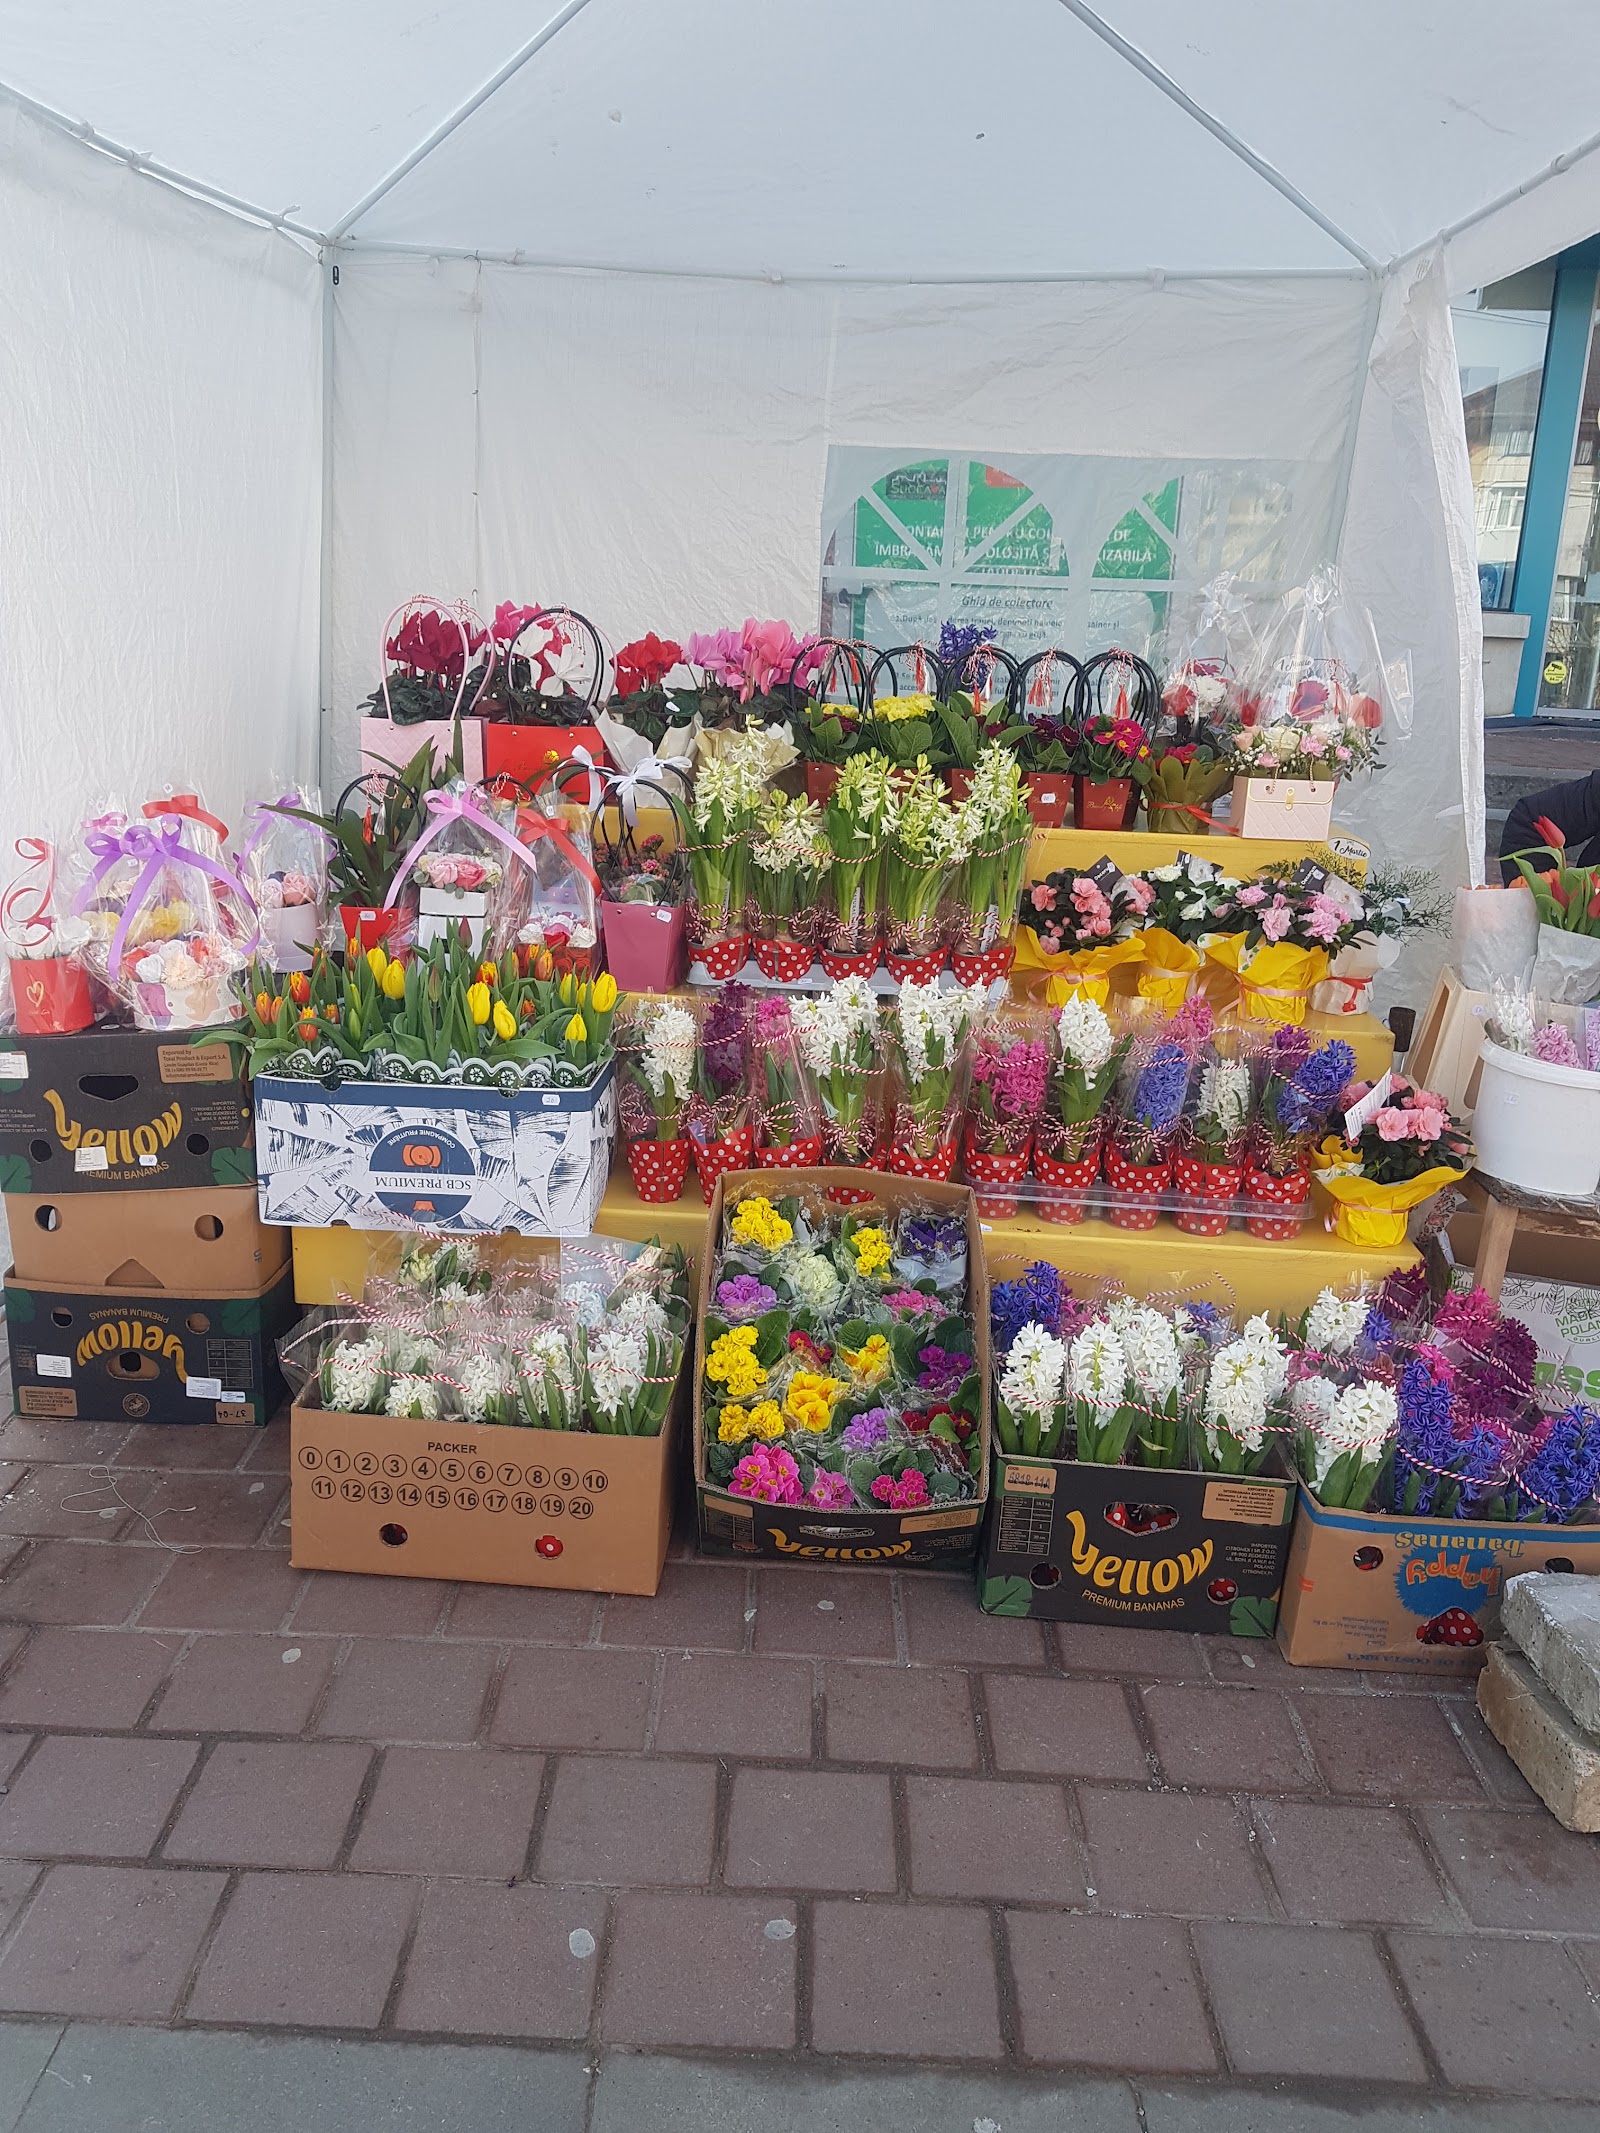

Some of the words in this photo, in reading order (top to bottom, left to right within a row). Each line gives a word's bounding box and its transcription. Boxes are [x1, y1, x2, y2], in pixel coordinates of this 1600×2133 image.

[1113, 528, 1132, 541] DE
[962, 596, 985, 608] Ghid
[989, 596, 1002, 608] de
[1004, 598, 1054, 610] colectare
[1333, 840, 1341, 852] 1
[1340, 845, 1368, 858] Martie
[387, 1129, 418, 1147] FRUITIÈRE
[417, 1129, 456, 1150] COMPAGNIE
[123, 1161, 170, 1181] BANANAS
[374, 1175, 443, 1190] PREMIUM
[442, 1178, 472, 1191] SCB
[88, 1307, 129, 1321] BANANAS
[128, 1308, 170, 1325] PREMIUM
[427, 1441, 478, 1456] PACKER
[306, 1451, 316, 1465] 0
[333, 1455, 341, 1469] 1
[361, 1457, 371, 1471] 2
[390, 1460, 400, 1473] 3
[418, 1462, 429, 1475] 4
[447, 1464, 458, 1477] 5
[476, 1466, 486, 1480] 6
[504, 1468, 515, 1482] 7
[532, 1470, 543, 1484] 8
[561, 1473, 572, 1487] 9
[586, 1474, 606, 1489] 10
[315, 1481, 332, 1494] 11
[343, 1484, 363, 1499] 12
[371, 1486, 391, 1500] 13
[399, 1488, 419, 1502] 14
[427, 1490, 448, 1504] 15
[457, 1491, 477, 1506] 16
[486, 1494, 507, 1509] 17
[515, 1496, 534, 1511] 18
[543, 1499, 563, 1513] 19
[572, 1501, 591, 1515] 20
[1394, 1530, 1525, 1558] bananas
[1405, 1551, 1502, 1596] happy
[1081, 1589, 1132, 1611] PREMIUM
[1133, 1597, 1185, 1612] BANANAS
